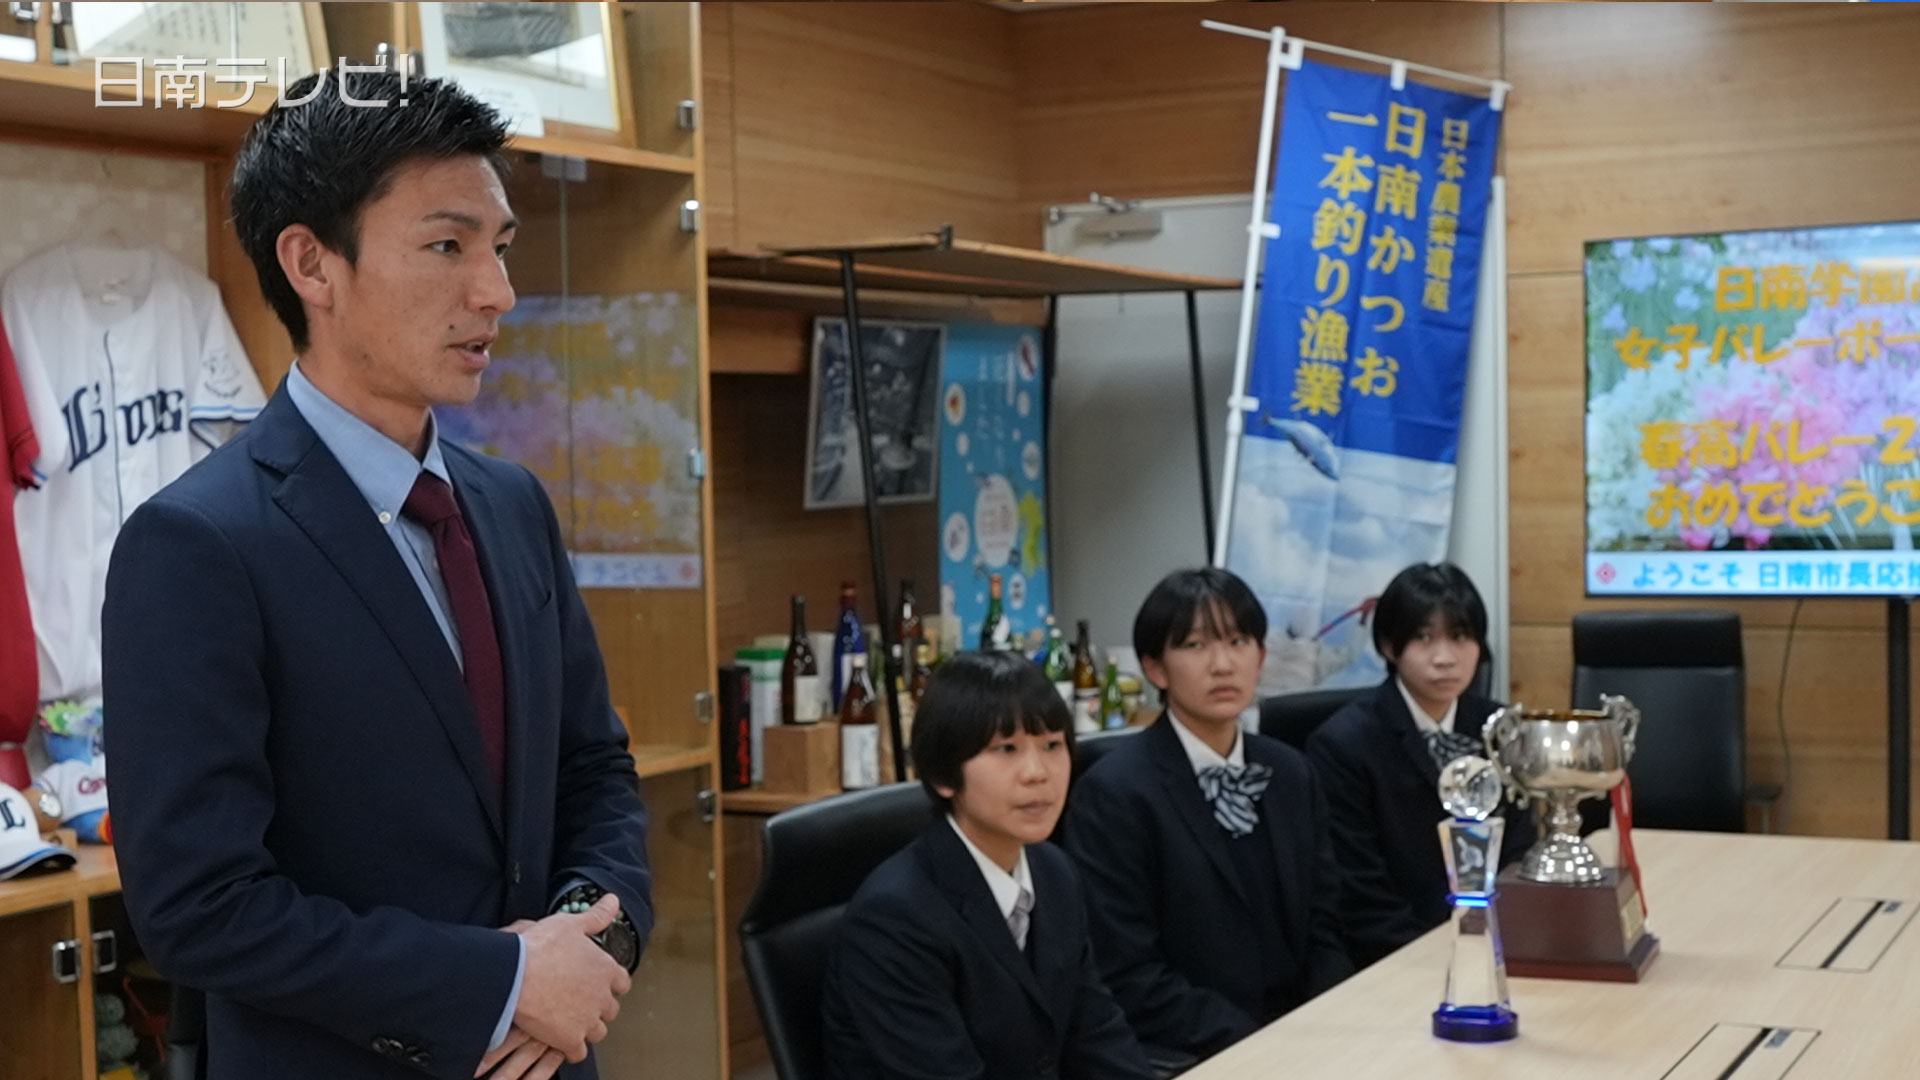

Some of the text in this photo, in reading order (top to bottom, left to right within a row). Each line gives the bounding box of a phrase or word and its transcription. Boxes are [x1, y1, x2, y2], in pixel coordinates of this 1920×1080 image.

[1291, 110, 1379, 417] 一本釣り漁業
[1350, 102, 1427, 398] 日南かつお
[1715, 261, 1920, 312] 日南学園
[1640, 415, 1920, 468] 春高バレー2
[1633, 562, 1742, 587] ようこそ
